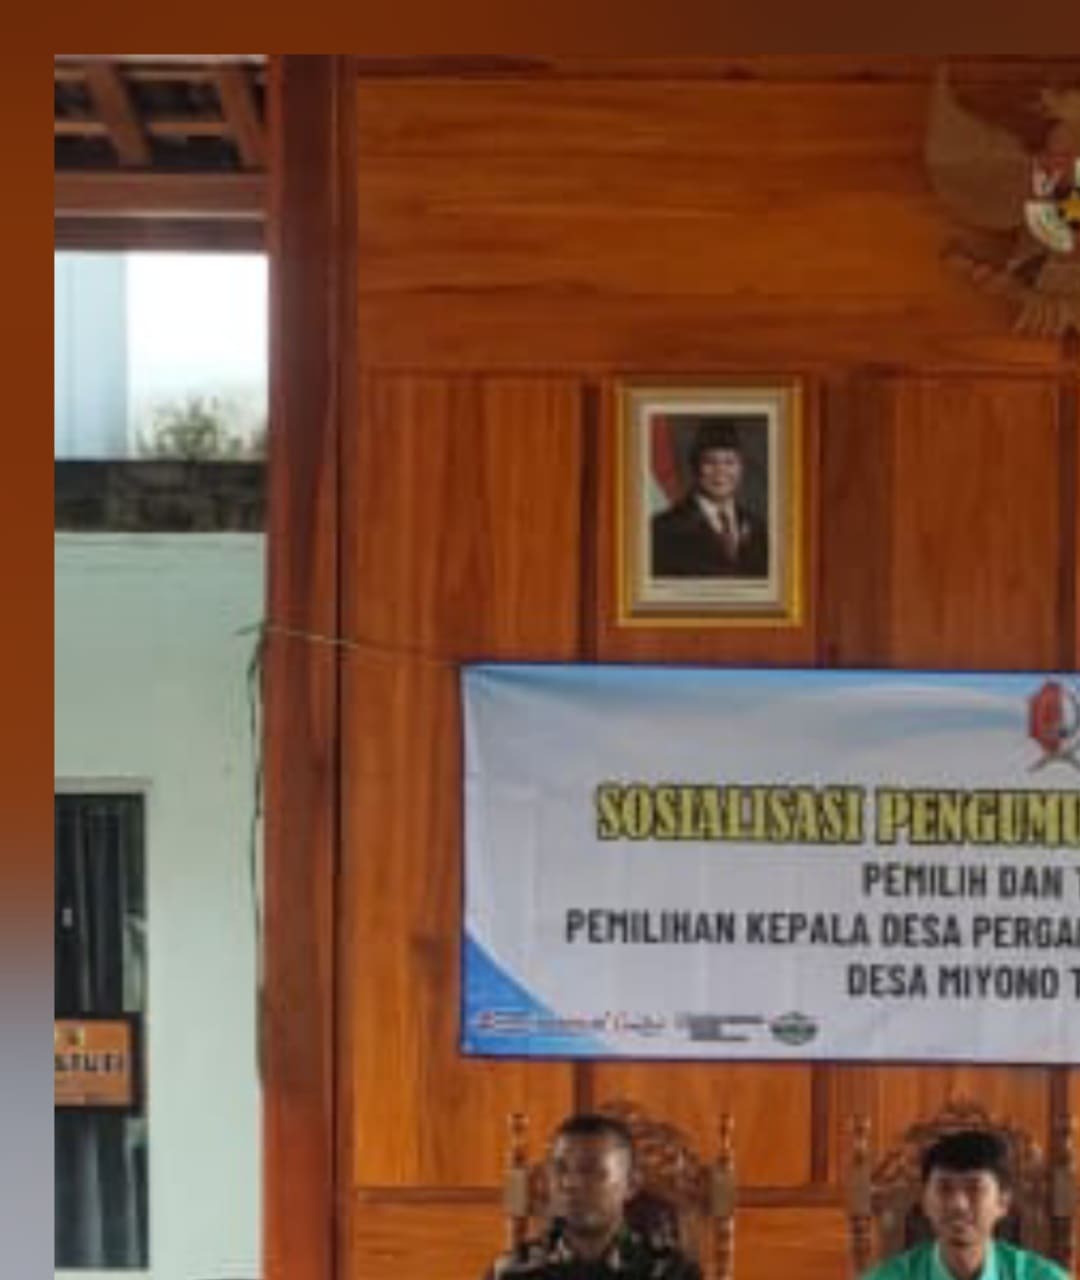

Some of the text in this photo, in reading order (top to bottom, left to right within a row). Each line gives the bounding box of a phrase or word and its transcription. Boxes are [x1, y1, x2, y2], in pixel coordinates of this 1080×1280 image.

[594, 782, 866, 845] SOSIALISASI
[863, 863, 988, 897] PEMILIH
[1000, 866, 1063, 897] DAN
[565, 909, 737, 944] PEMILIHAN
[747, 911, 870, 946] KEPALA
[881, 913, 961, 947] DESA
[847, 964, 927, 997] DESA
[938, 966, 1059, 1000] MIYONO
